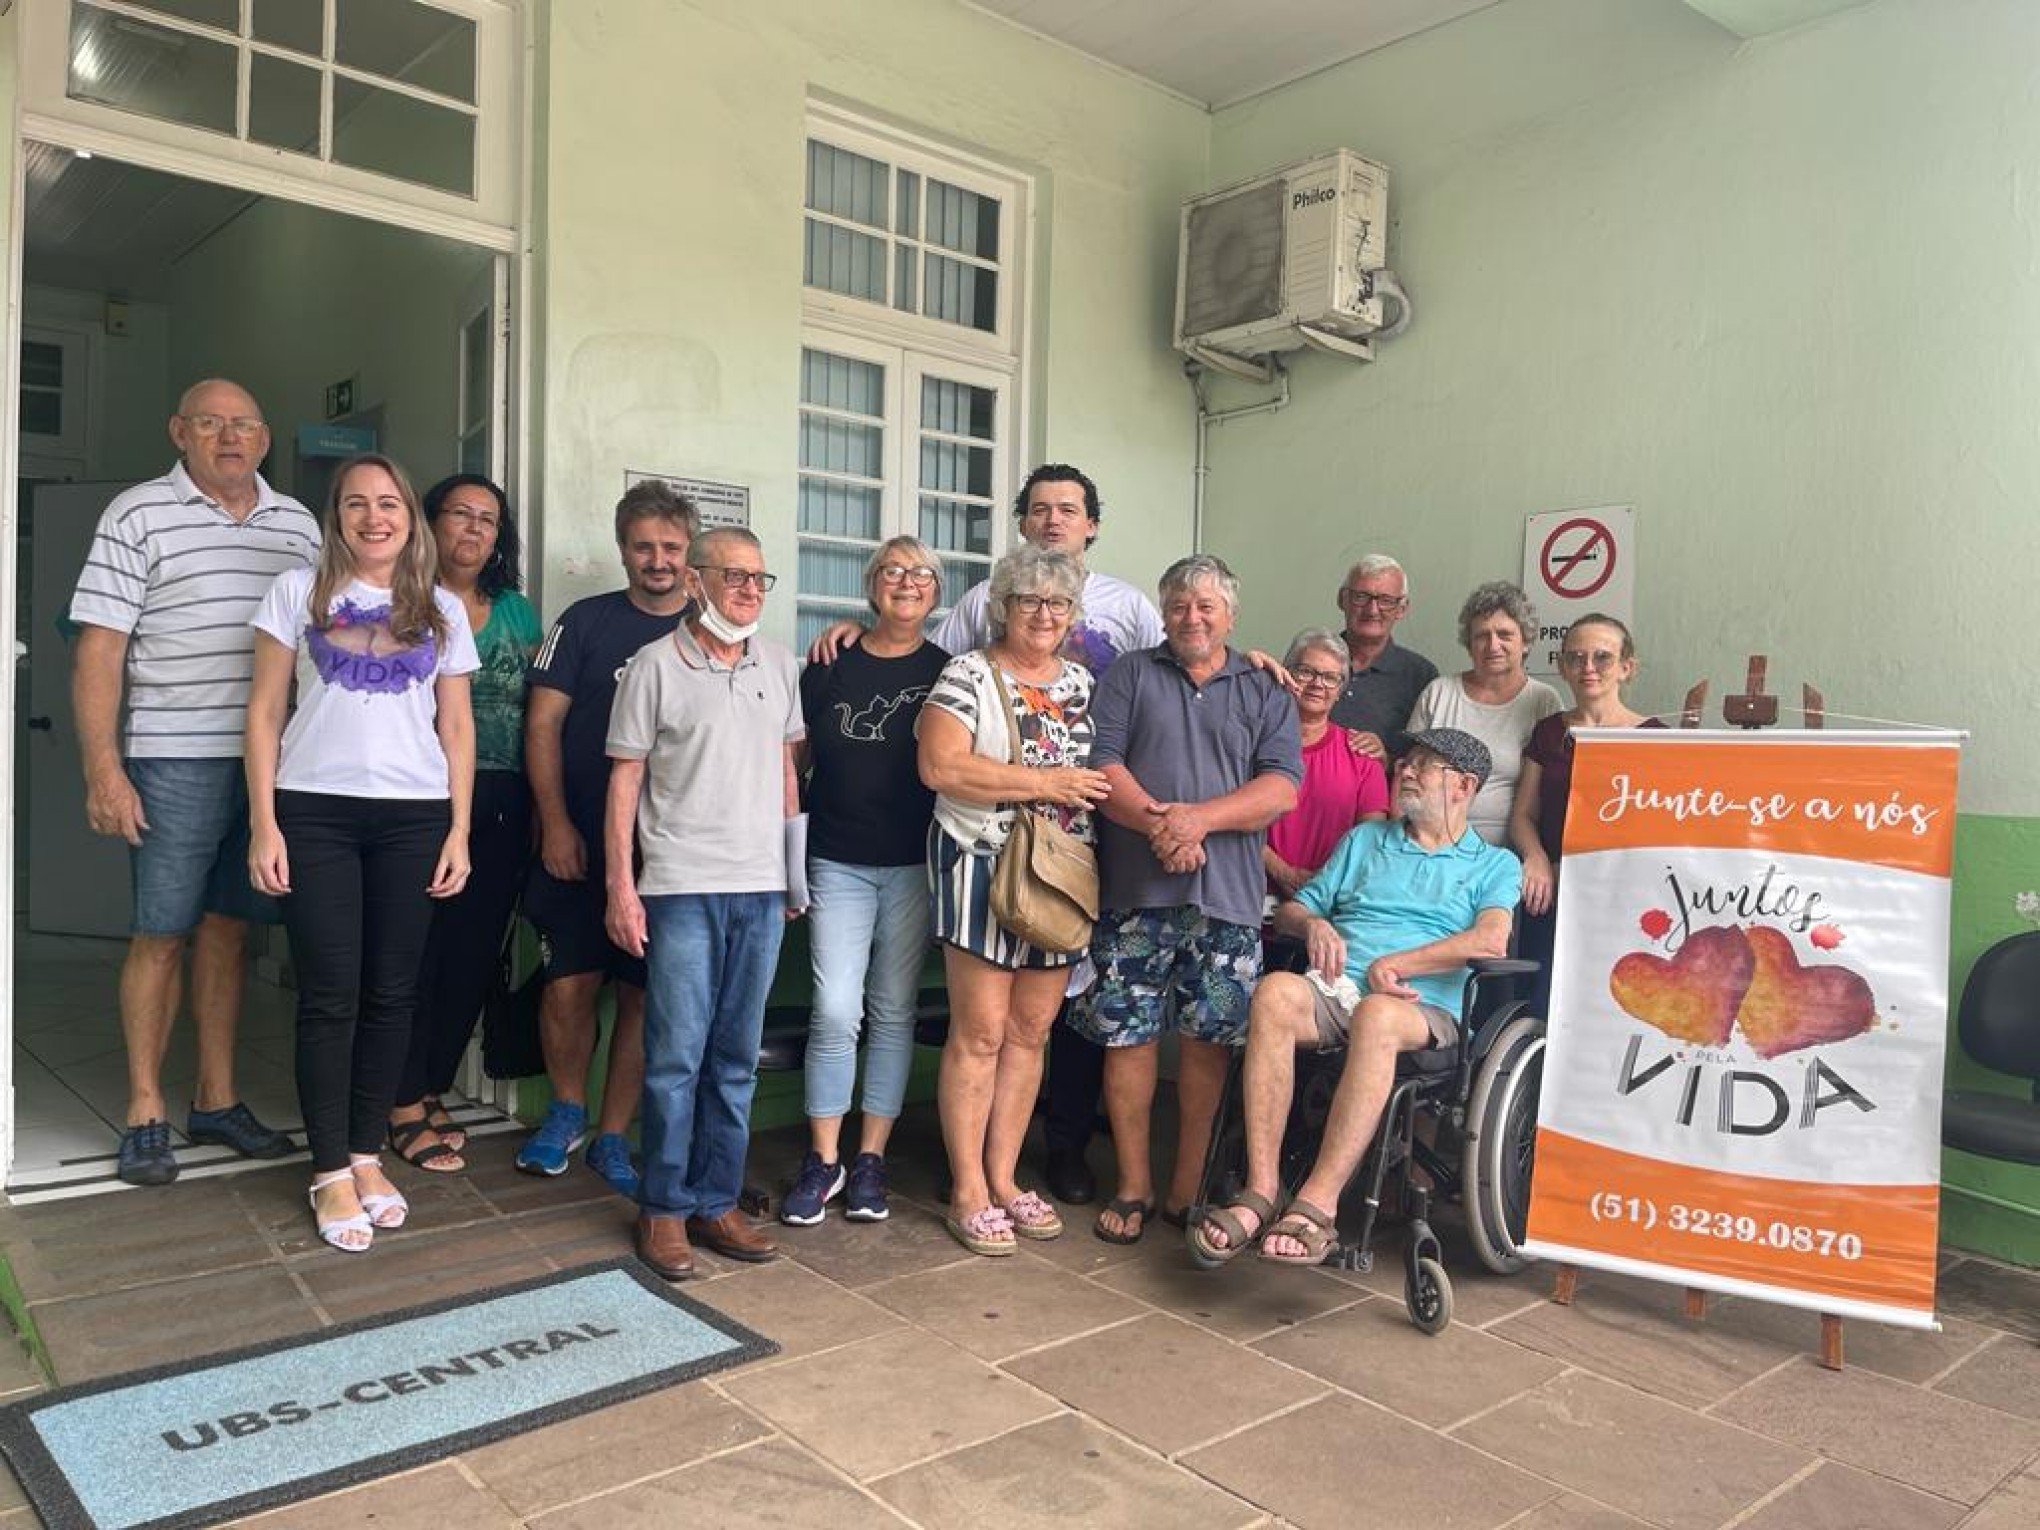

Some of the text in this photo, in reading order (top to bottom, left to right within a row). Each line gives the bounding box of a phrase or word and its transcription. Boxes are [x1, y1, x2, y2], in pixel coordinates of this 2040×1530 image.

[330, 652, 411, 684] VIDA
[1600, 774, 1939, 836] Junte-se a nós
[1663, 863, 1831, 953] juntos
[1617, 1034, 1878, 1137] VIDA
[1695, 1049, 1737, 1064] PELA
[1591, 1192, 1863, 1261] (51) 3239.0870
[160, 1320, 620, 1453] UBS-CENTRAL
